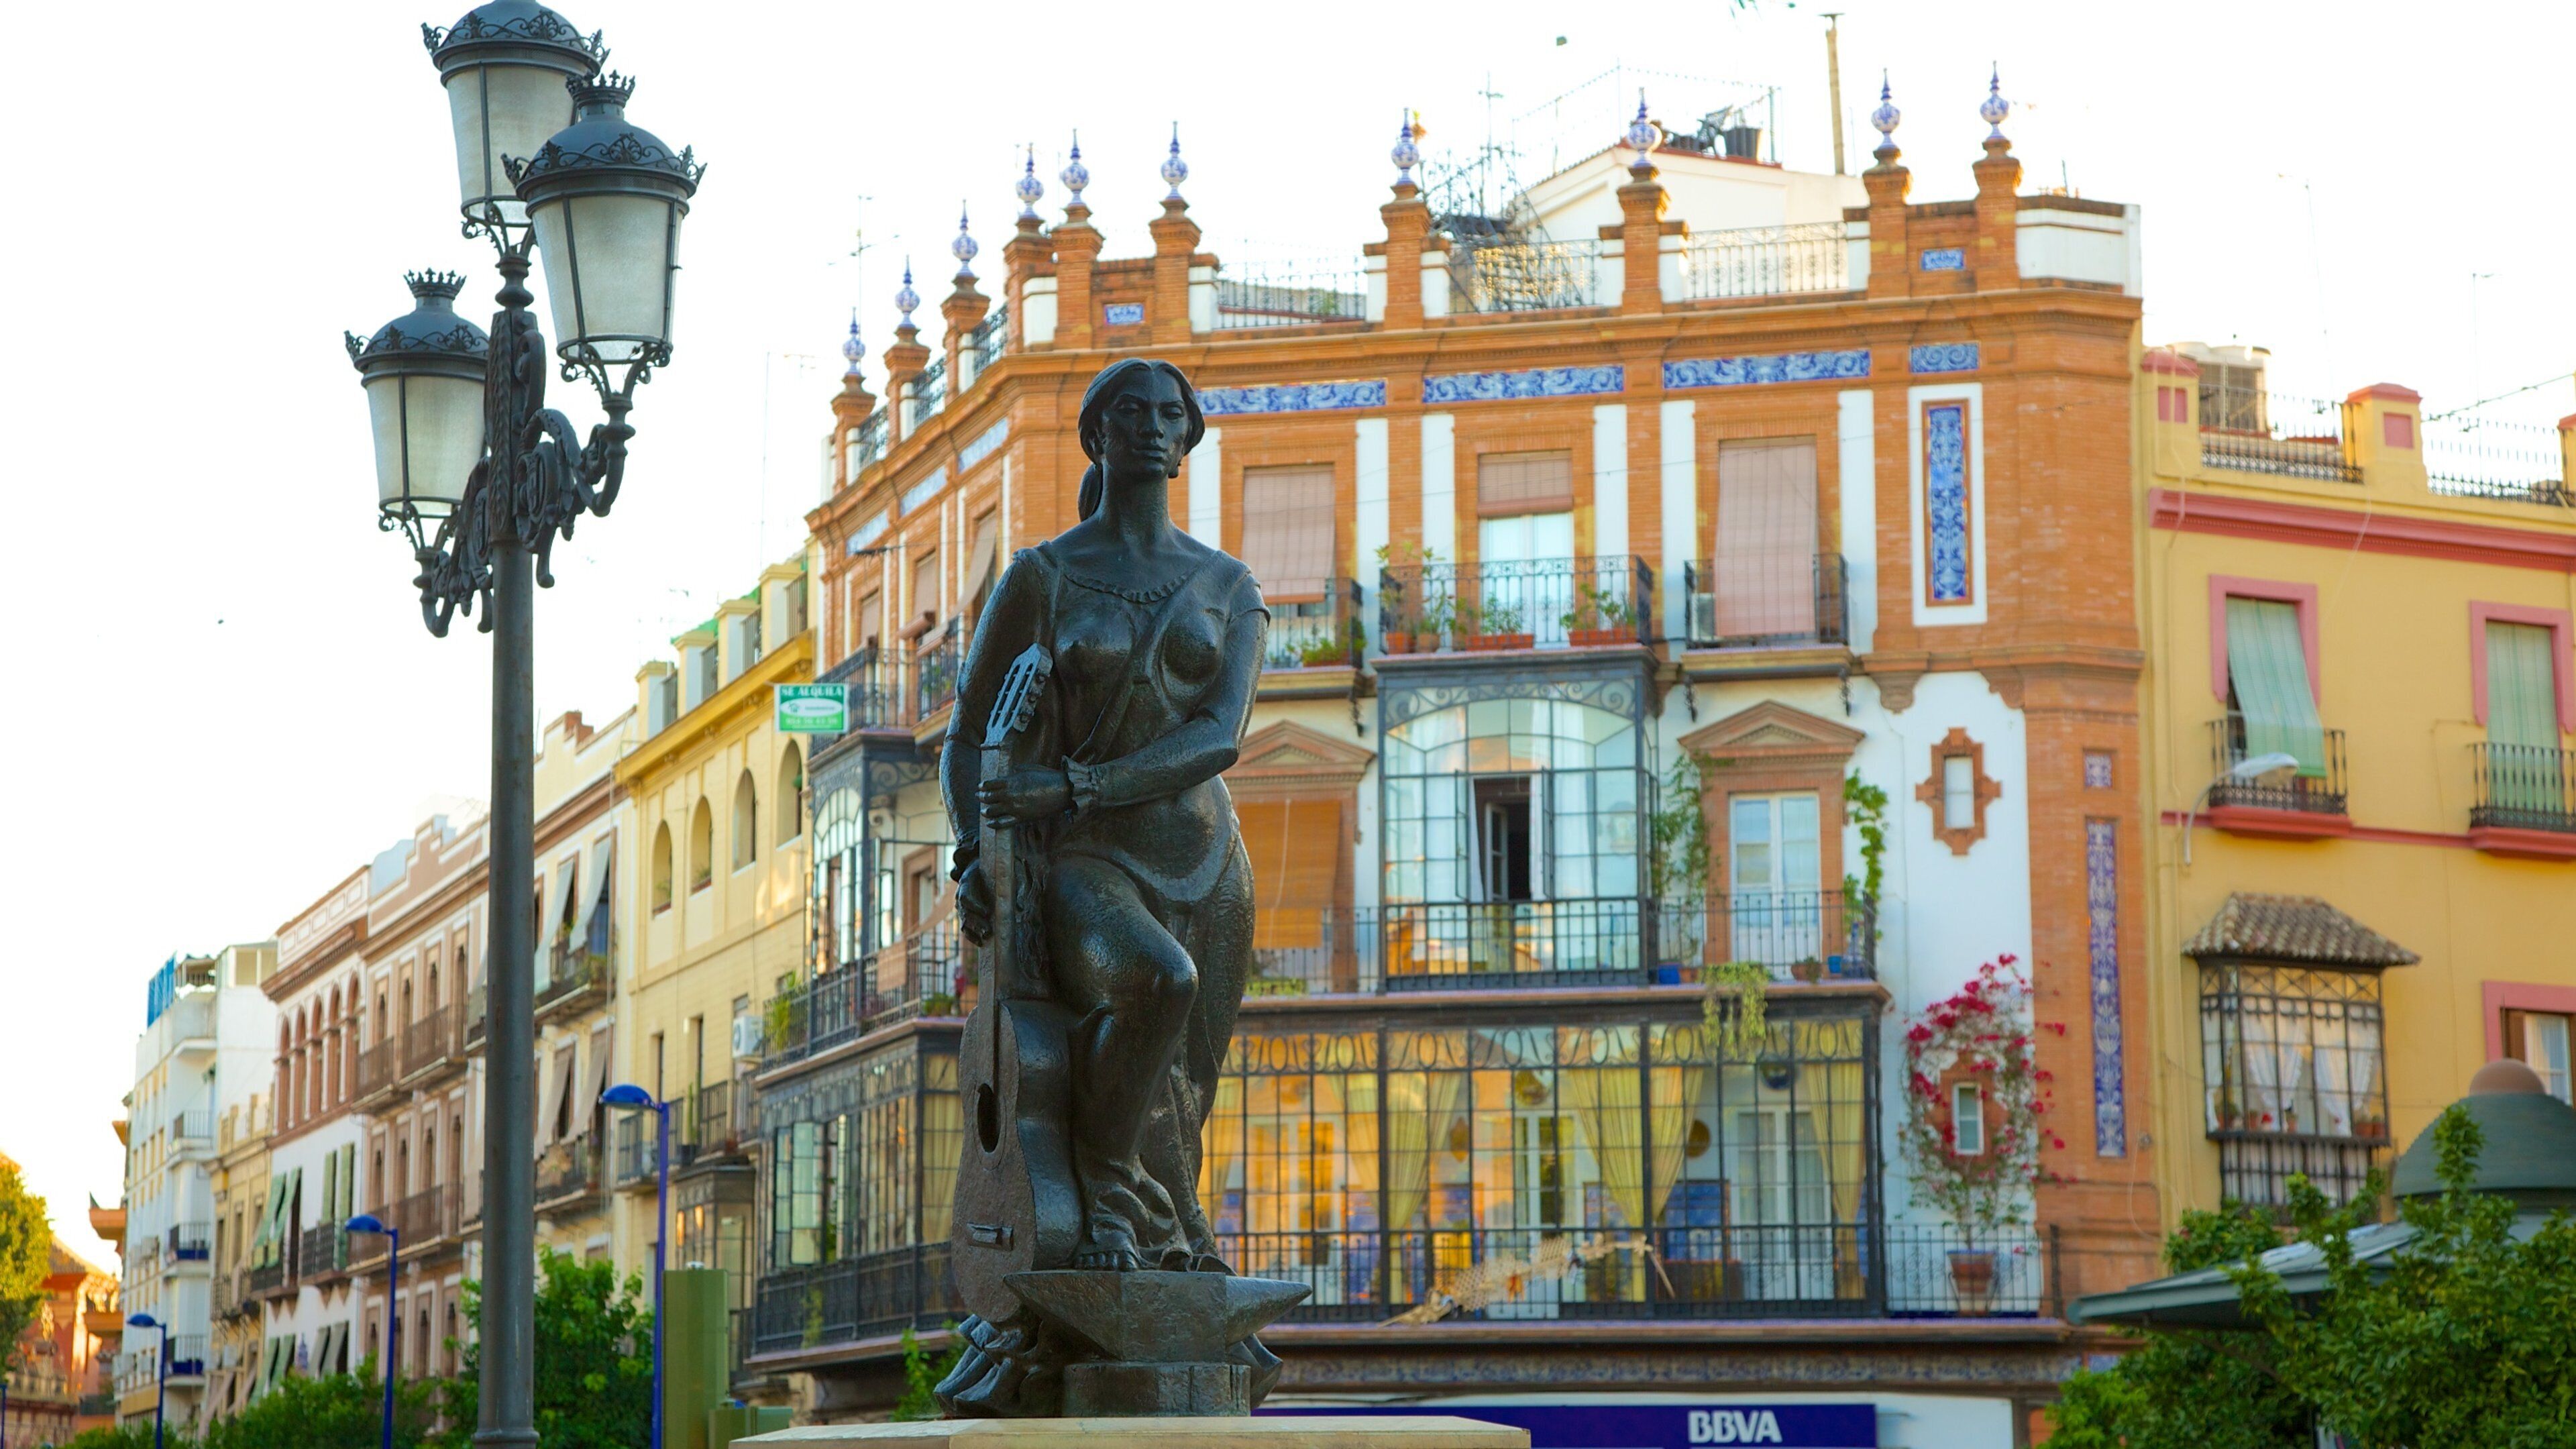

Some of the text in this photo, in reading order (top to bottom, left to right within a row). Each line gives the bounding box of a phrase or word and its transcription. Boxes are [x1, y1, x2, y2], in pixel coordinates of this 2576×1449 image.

[782, 686, 843, 698] SE ALQUILA
[1688, 1410, 1782, 1443] BBVA
